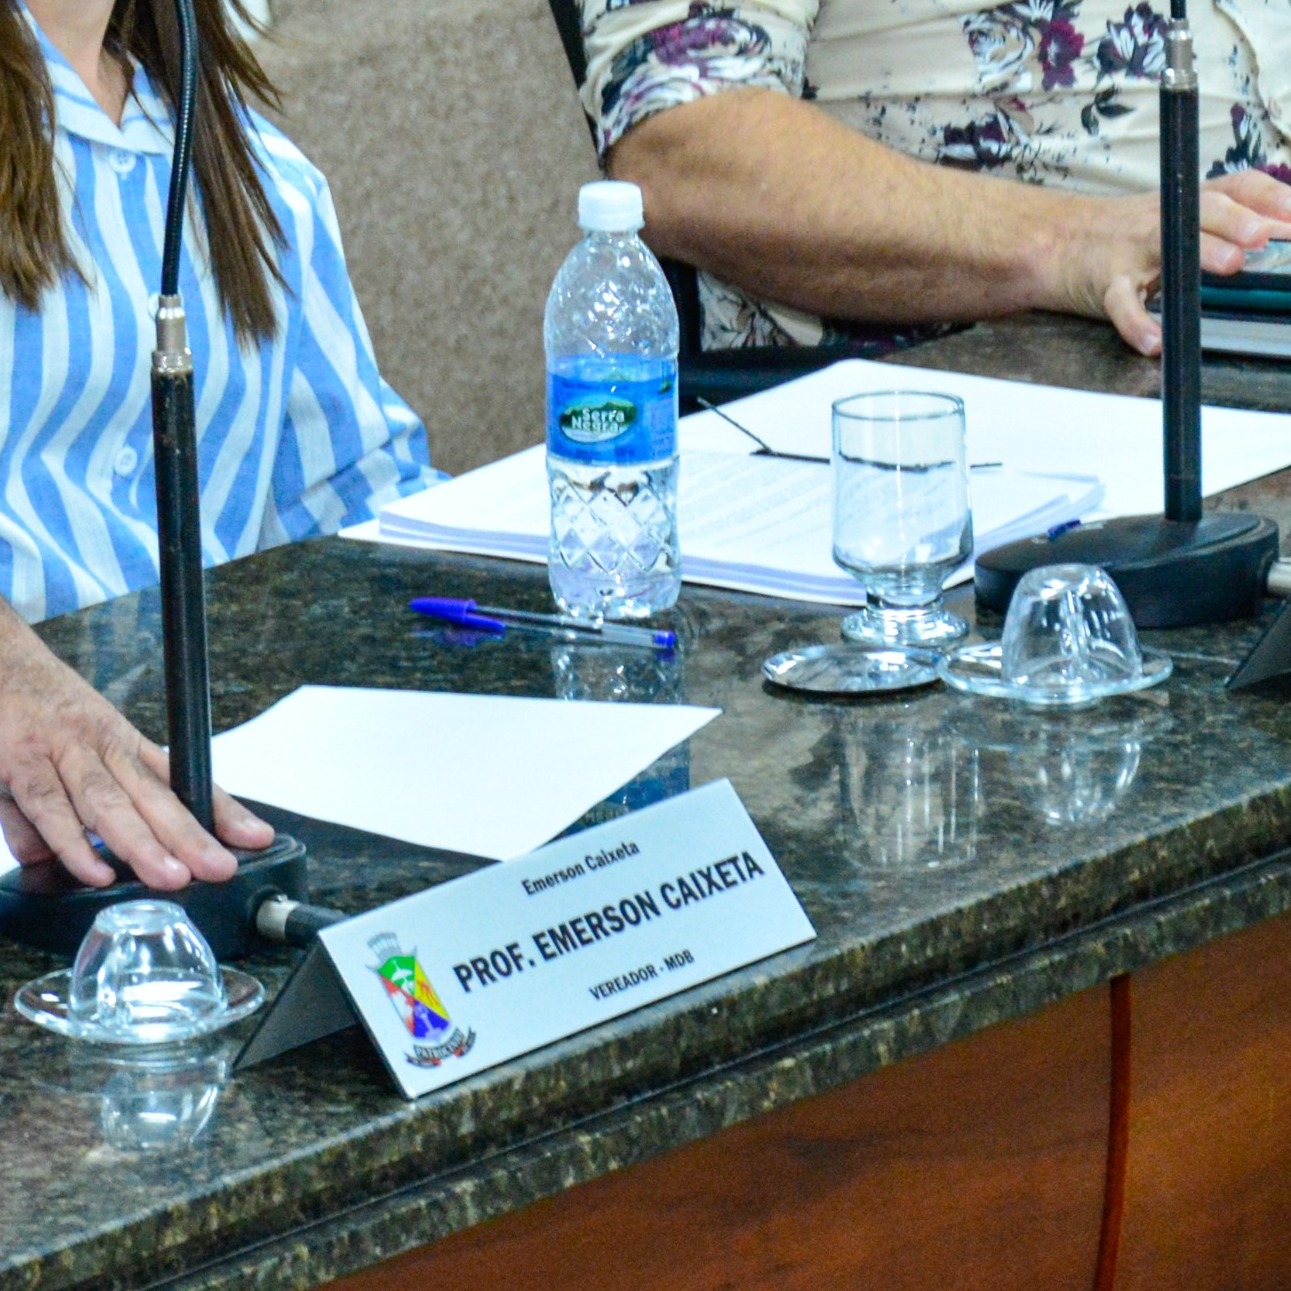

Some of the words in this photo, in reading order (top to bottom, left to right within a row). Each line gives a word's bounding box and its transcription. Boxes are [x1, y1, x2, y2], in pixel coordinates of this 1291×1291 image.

[571, 415, 621, 435] Negra
[582, 407, 625, 423] Serra
[521, 862, 586, 896] Emerson
[584, 841, 640, 871] Caixeta
[452, 941, 537, 993] PROF.
[531, 890, 662, 961] EMERSON
[659, 850, 766, 911] CAIXETA
[588, 964, 658, 1001] VEREADOR
[663, 949, 695, 973] MDB
